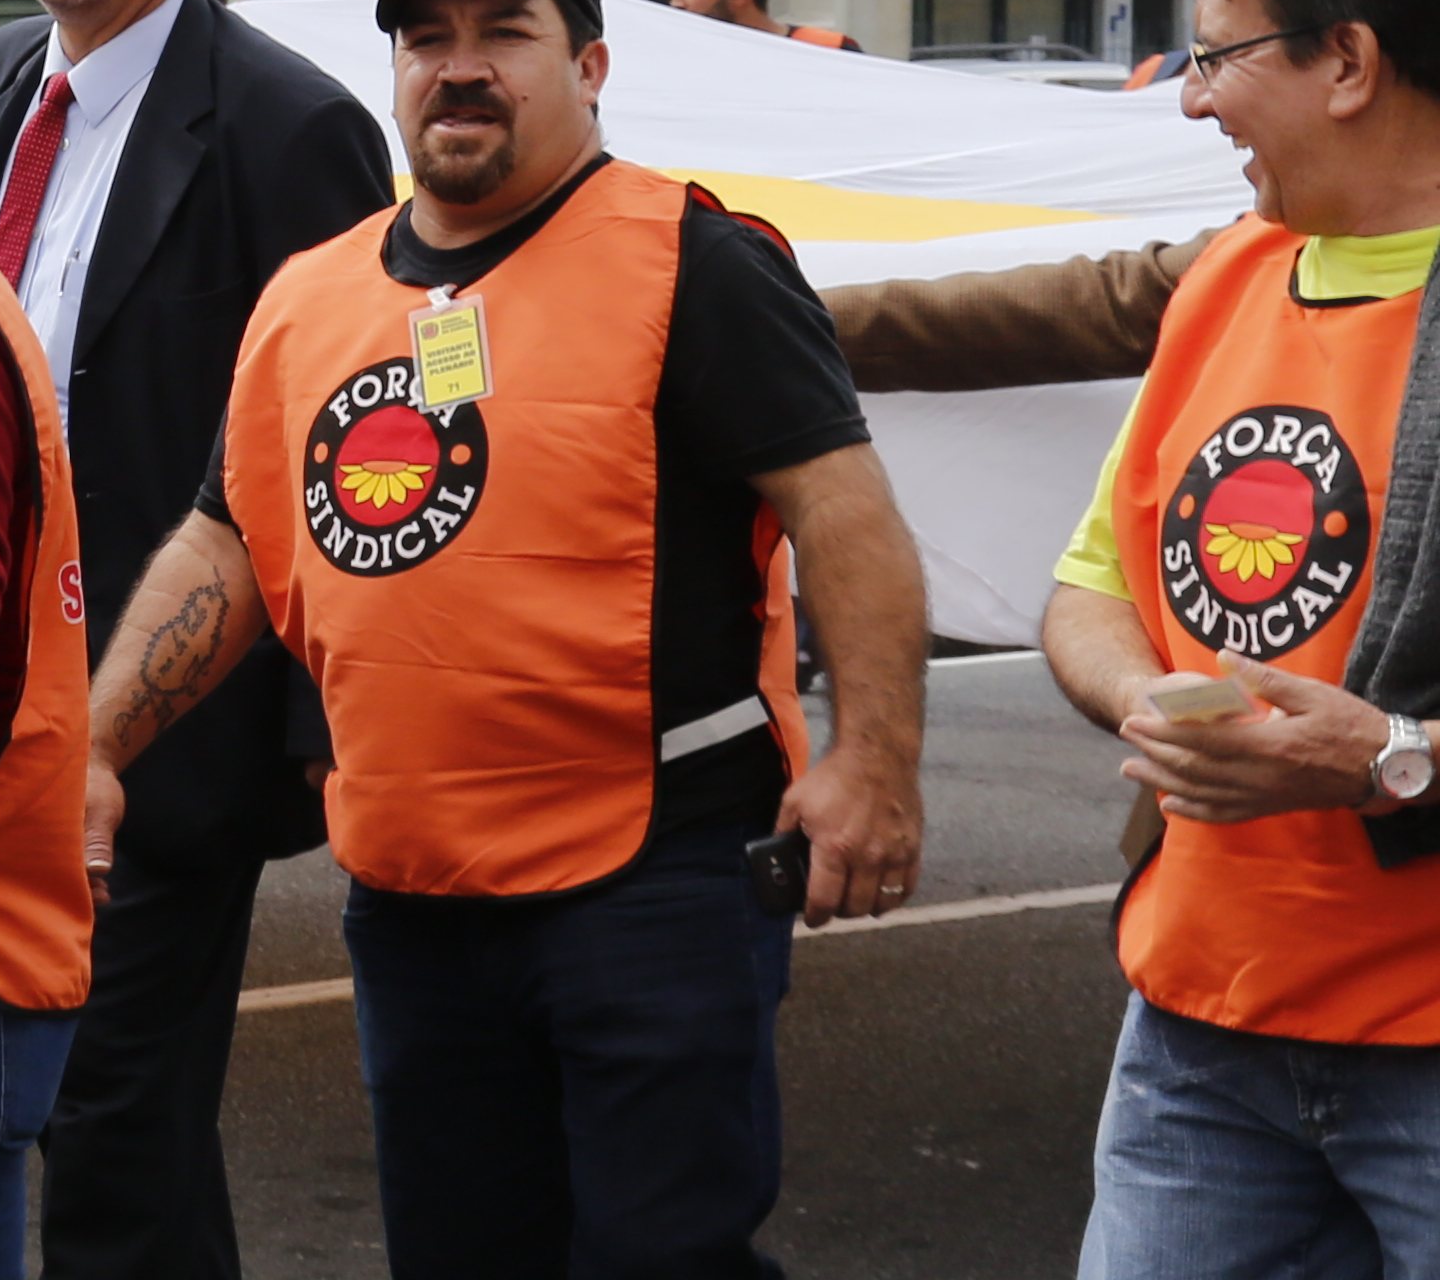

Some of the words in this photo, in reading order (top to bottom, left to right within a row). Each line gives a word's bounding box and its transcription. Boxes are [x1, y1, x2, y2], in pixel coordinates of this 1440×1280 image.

[1200, 415, 1343, 493] FORÇA
[306, 482, 476, 569] SINDICAL
[1164, 539, 1353, 655] SINDICAL
